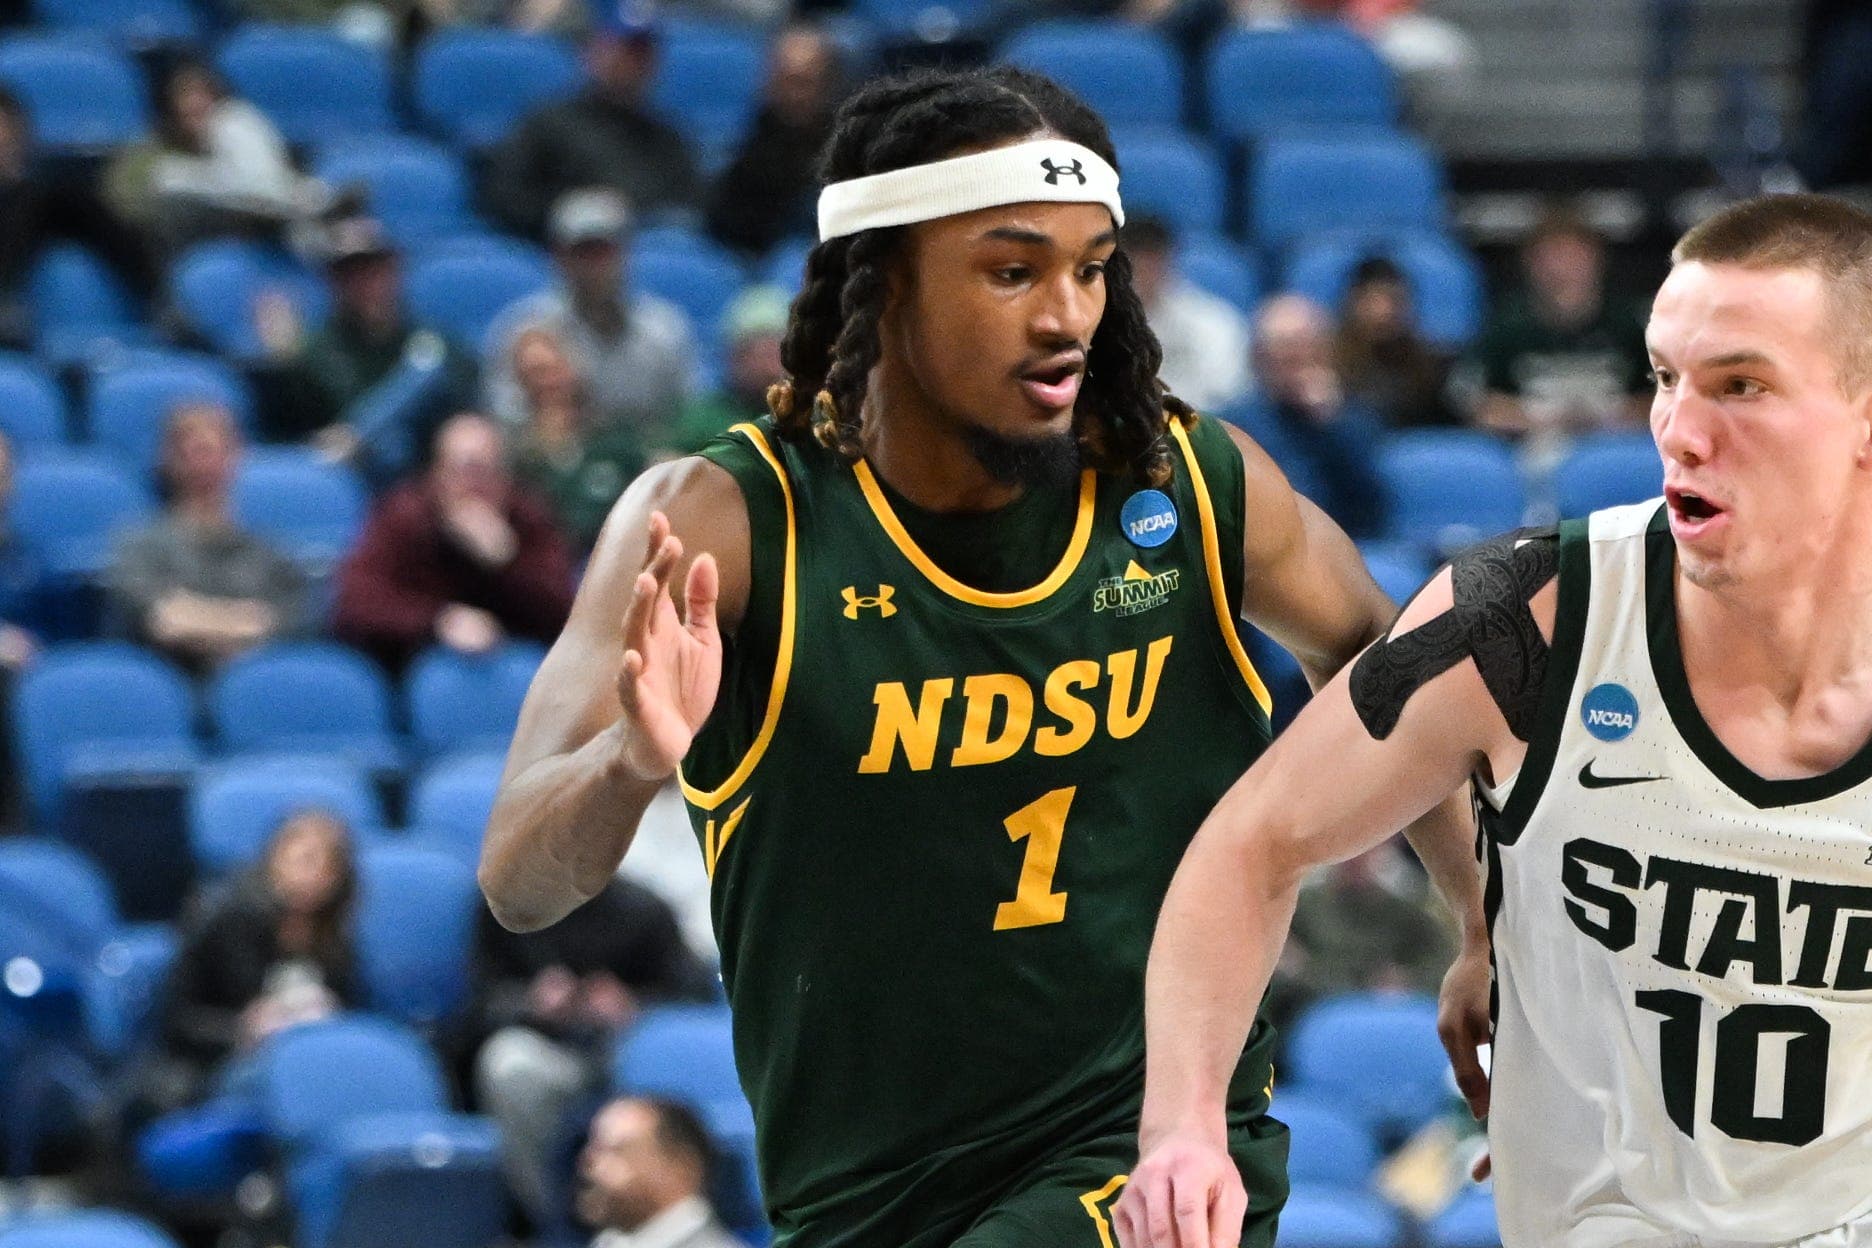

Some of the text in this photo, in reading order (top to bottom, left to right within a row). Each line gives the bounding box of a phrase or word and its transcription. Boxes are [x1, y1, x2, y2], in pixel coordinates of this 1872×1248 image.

[1129, 511, 1175, 536] NCAA
[1093, 568, 1180, 613] SUMMIT
[857, 636, 1173, 774] NDSU
[1587, 709, 1633, 729] NCAA
[993, 786, 1076, 931] 1
[1635, 988, 1831, 1147] 10
